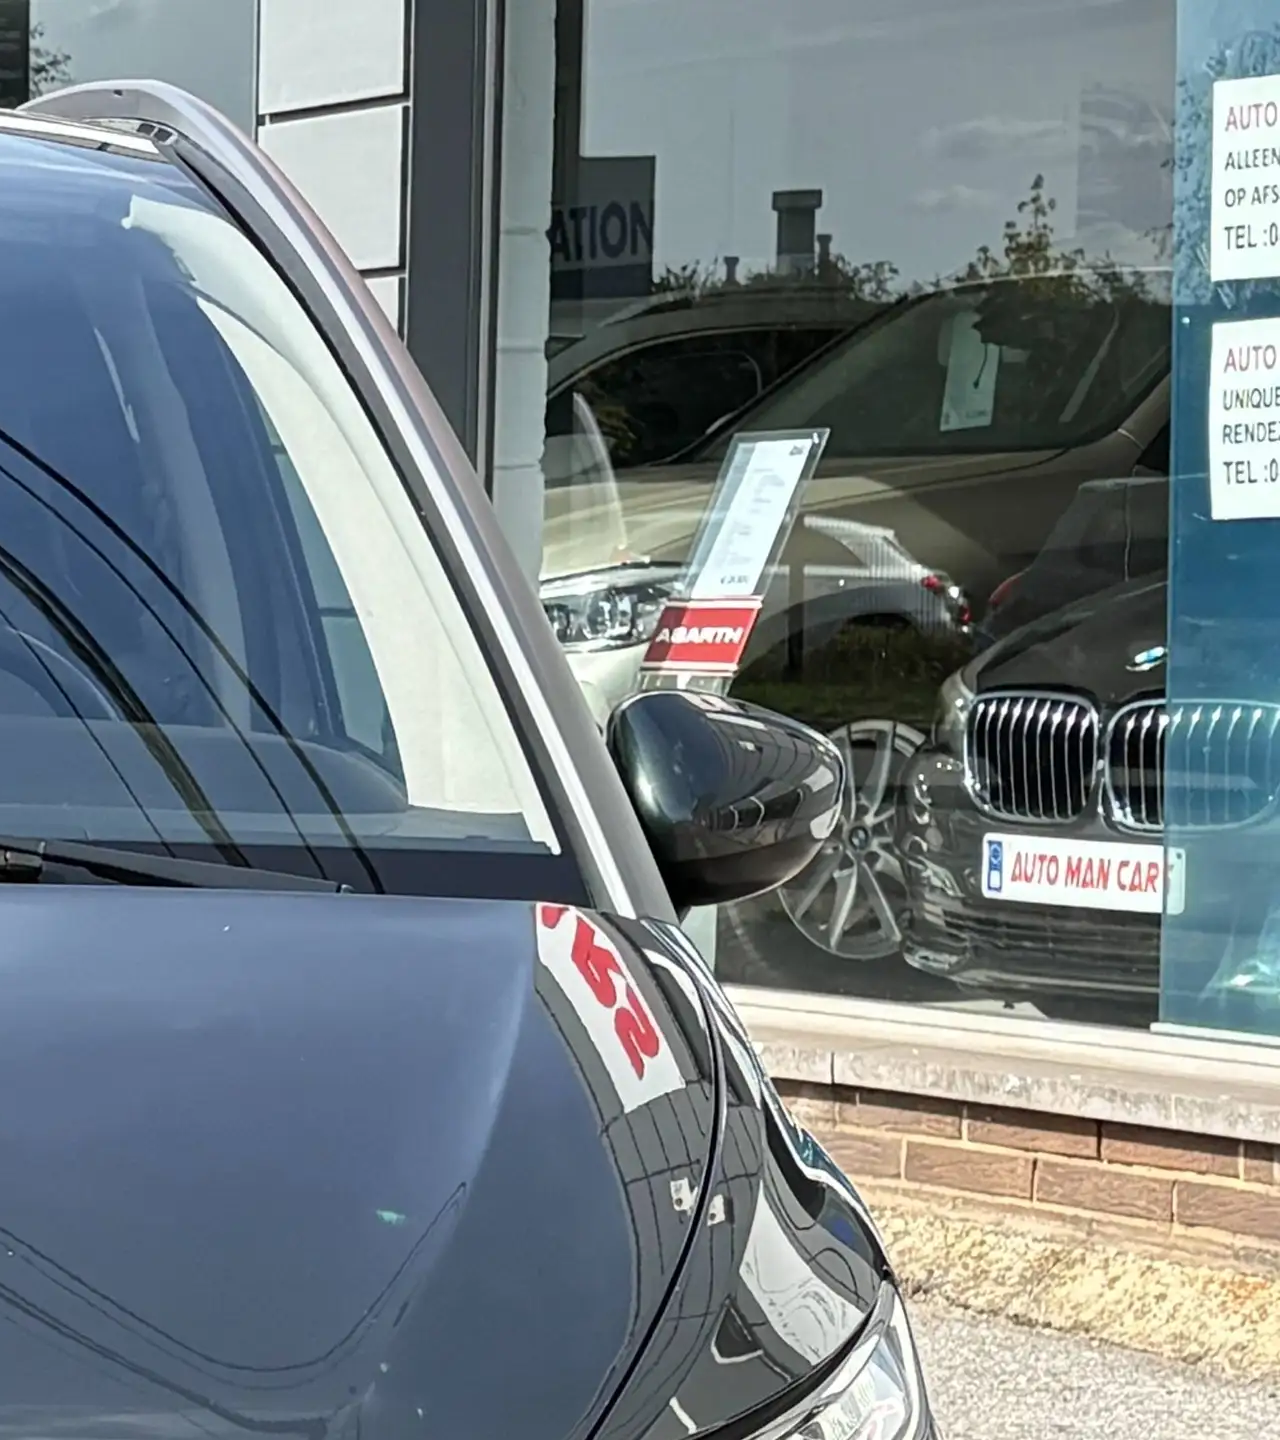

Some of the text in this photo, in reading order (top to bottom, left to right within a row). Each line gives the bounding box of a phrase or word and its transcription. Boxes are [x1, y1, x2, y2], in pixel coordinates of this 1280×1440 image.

[1225, 101, 1278, 132] AUTO
[1224, 187, 1247, 208] OP
[1224, 224, 1258, 250] TEL
[1224, 344, 1277, 373] AUTO
[1223, 420, 1280, 444] RENDE
[1223, 460, 1258, 485] TEL
[655, 626, 744, 645] ABARTH
[1010, 851, 1060, 886] AUTO
[1064, 855, 1111, 891] MAN
